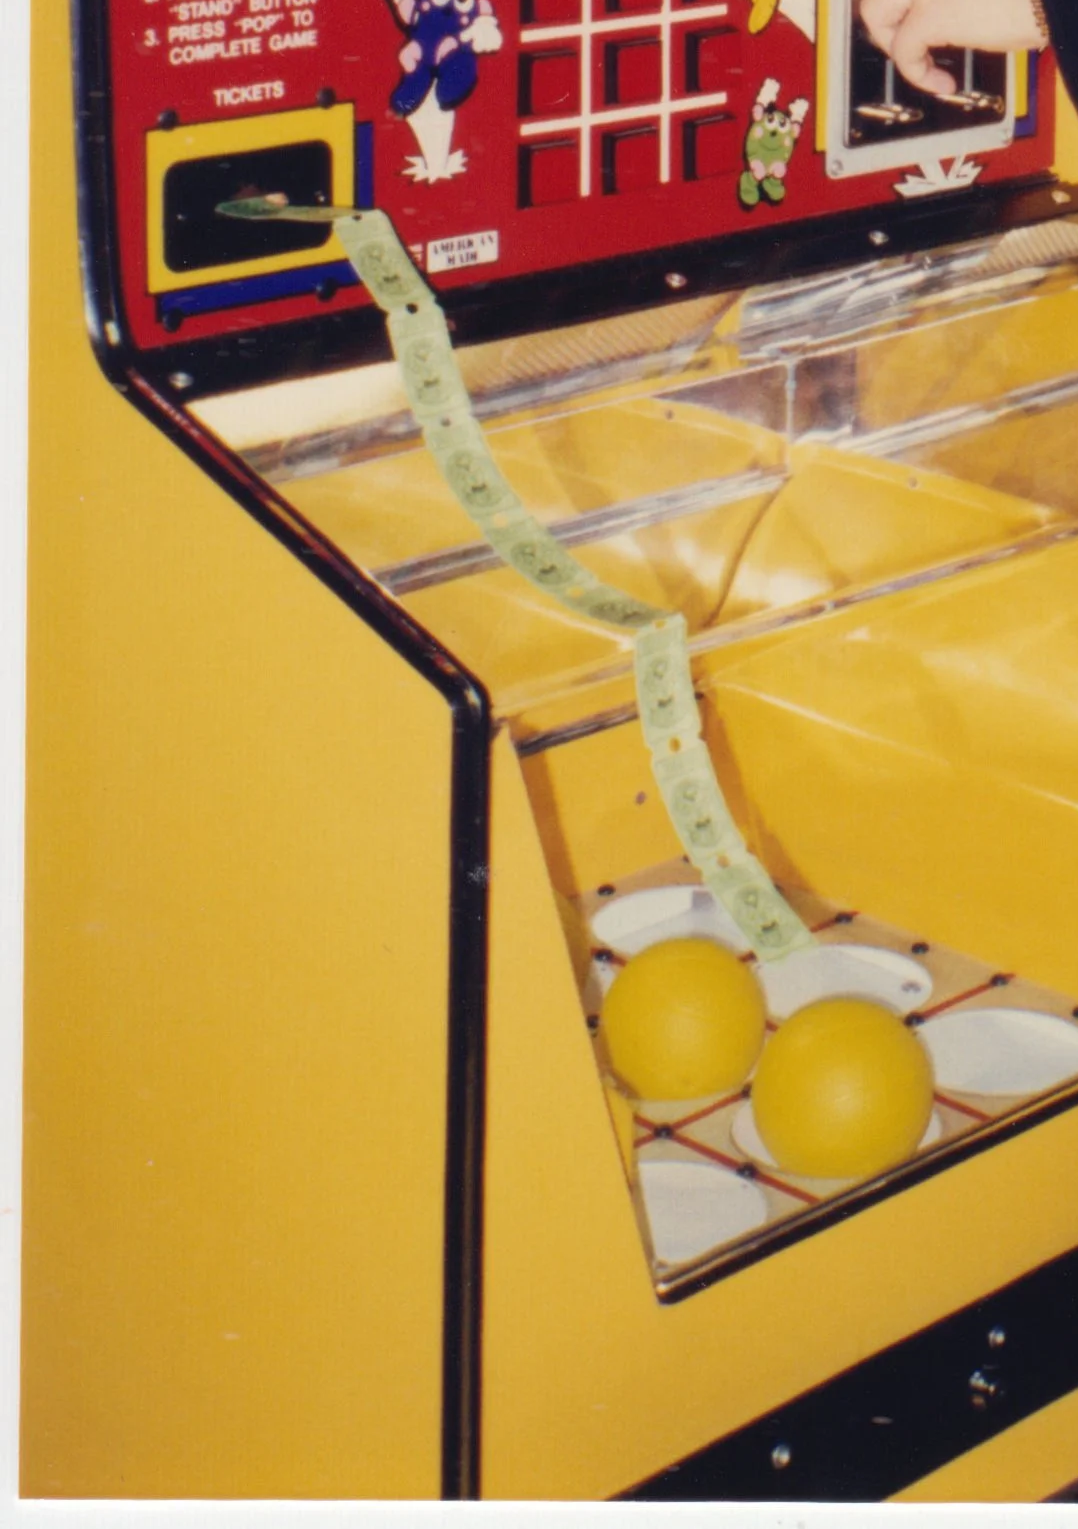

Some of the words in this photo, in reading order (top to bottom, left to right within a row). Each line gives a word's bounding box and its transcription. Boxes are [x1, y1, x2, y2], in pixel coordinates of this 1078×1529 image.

[144, 29, 160, 47] 3.
[168, 20, 226, 43] PRESS
[292, 10, 314, 27] TO
[169, 38, 261, 66] COMPLETE
[268, 30, 318, 52] GAME
[213, 81, 285, 107] TICKETS
